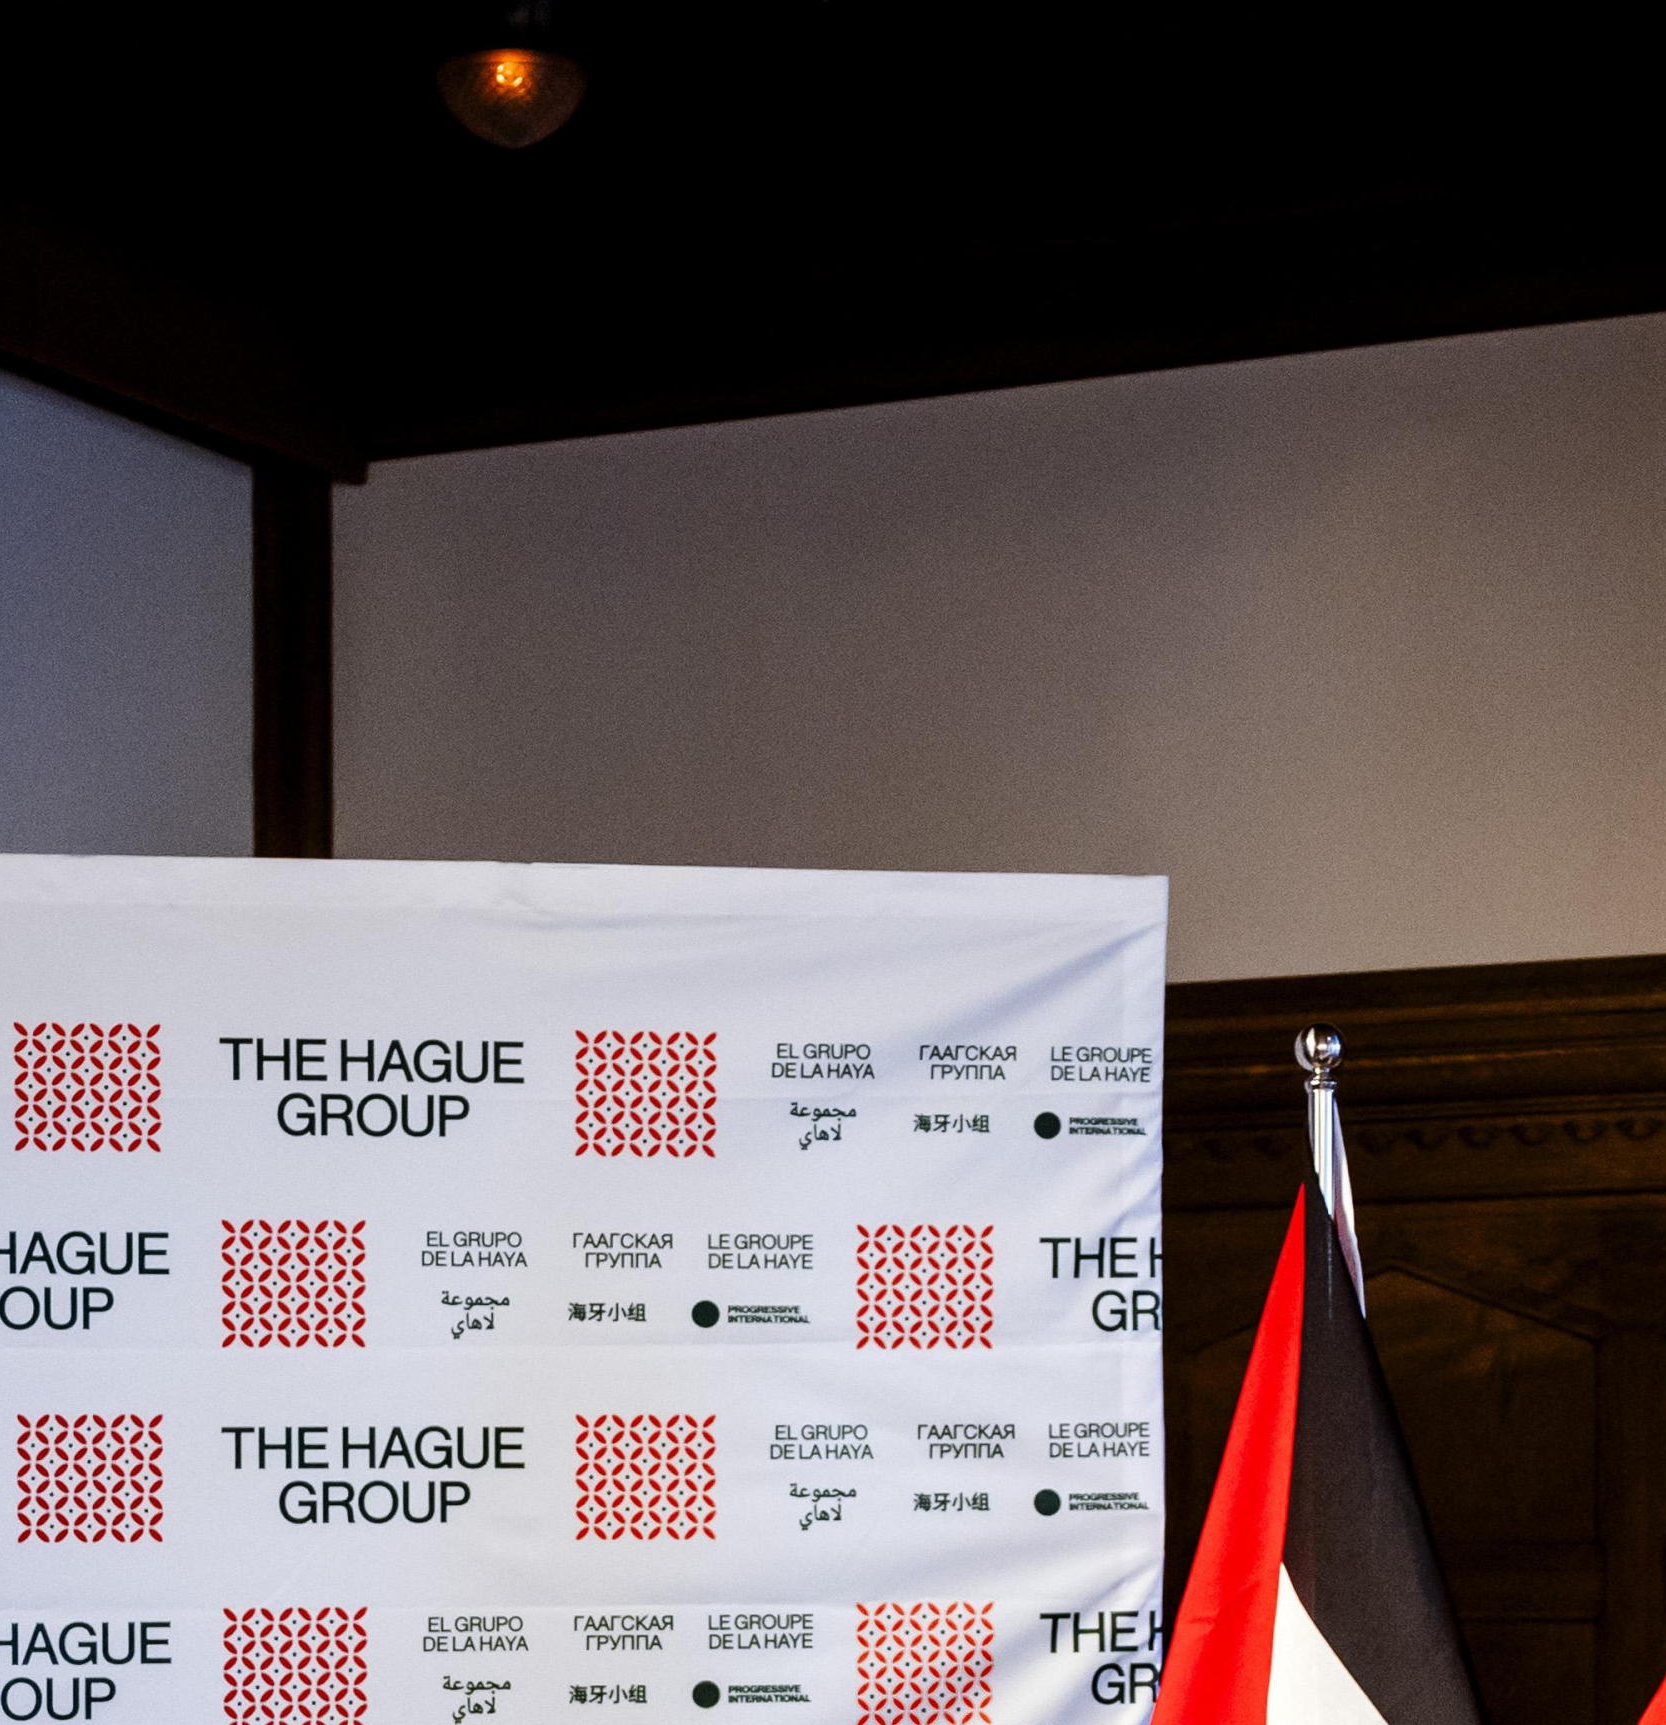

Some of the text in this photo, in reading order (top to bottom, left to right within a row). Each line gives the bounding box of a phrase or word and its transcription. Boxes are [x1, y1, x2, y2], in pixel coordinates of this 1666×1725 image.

[217, 1036, 526, 1086] THE HAGUE
[776, 1042, 872, 1061] EL GRUPO
[918, 1044, 1017, 1062] ГААГСКАЯ
[1050, 1045, 1153, 1065] LE GROUPE
[771, 1061, 876, 1080] DE LA HAYA
[930, 1063, 1006, 1081] ГРУППА
[1050, 1064, 1151, 1083] DE LA HAYE
[275, 1091, 471, 1139] GROUP
[789, 1101, 857, 1123] مجموعة
[913, 1113, 990, 1133] 海牙小组
[798, 1123, 842, 1151] لاهاي
[426, 1230, 523, 1249] EL GRUPO
[572, 1232, 674, 1249] ГААГСКАЯ
[707, 1233, 814, 1251] LE GROUPE
[421, 1250, 528, 1268] DE LA HAYA
[584, 1251, 662, 1269] ГРУППА
[708, 1252, 814, 1270] DE LA HAYE
[1038, 1236, 1139, 1279] THE
[440, 1290, 510, 1311] مجموعة
[568, 1302, 647, 1323] 海牙小组
[450, 1311, 495, 1340] لاهاي
[219, 1424, 527, 1471] THE HAGUE
[277, 1479, 472, 1526] GROUP
